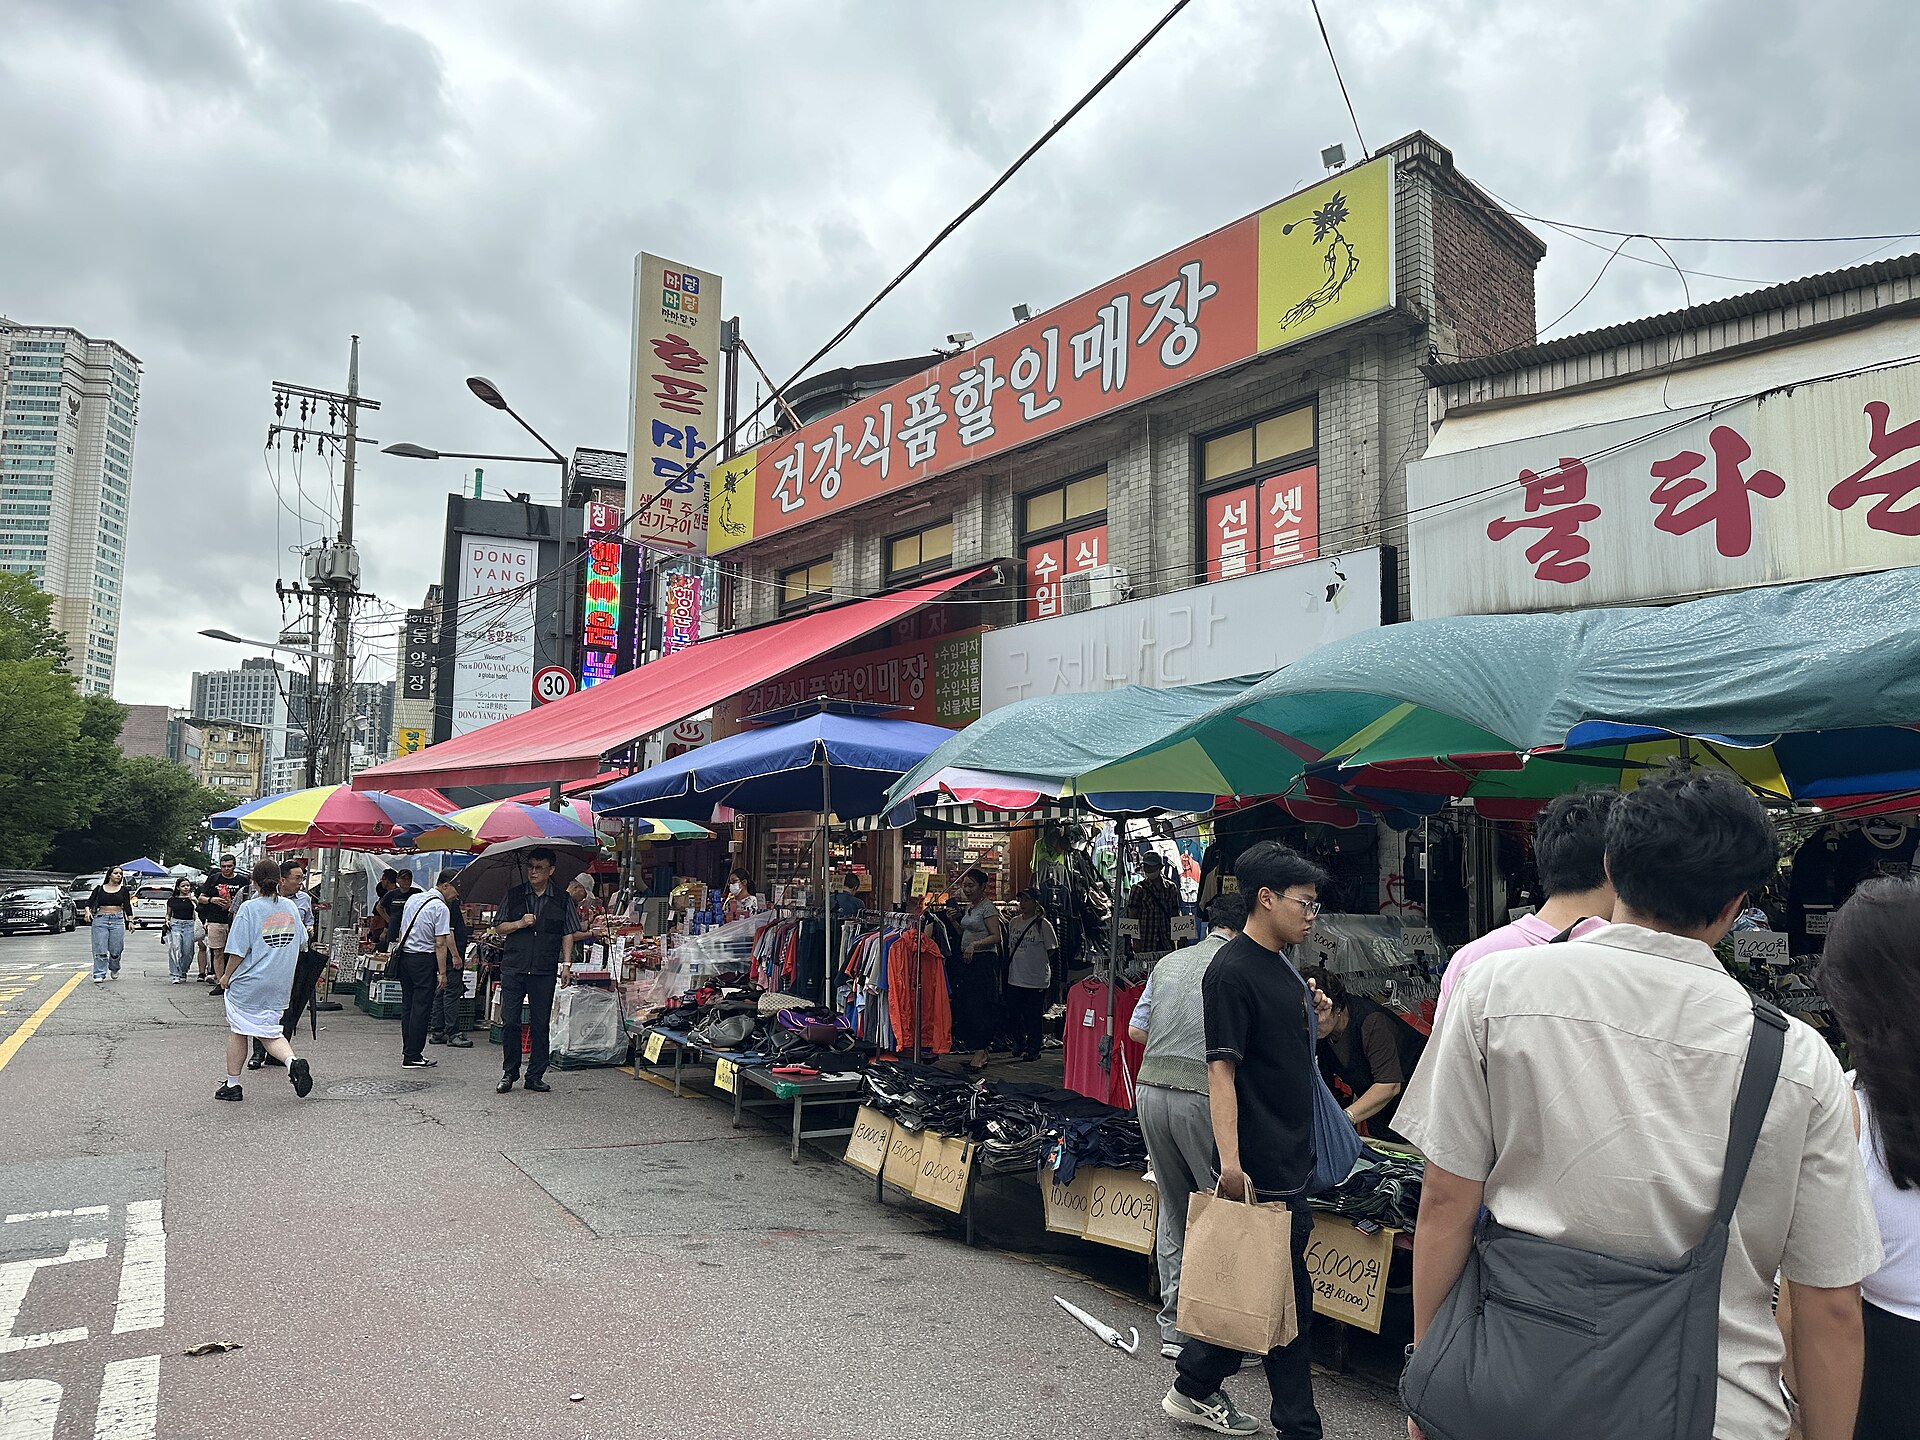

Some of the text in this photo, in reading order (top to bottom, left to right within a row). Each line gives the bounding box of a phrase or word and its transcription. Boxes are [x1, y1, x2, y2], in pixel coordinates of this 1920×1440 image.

[771, 261, 1218, 514] 건강식품할인매장
[639, 511, 691, 535] 전기구이
[473, 550, 526, 565] DONG
[473, 567, 525, 582] YANG
[405, 613, 435, 624] HOTEL
[409, 628, 428, 691] 동양장
[940, 639, 979, 661] 수입과자
[473, 662, 492, 671] DONG
[494, 663, 511, 672] YANG
[941, 658, 980, 680] 건강식품
[544, 675, 565, 695] 30
[941, 677, 980, 698] 수입식품
[458, 711, 478, 719] DONG
[479, 712, 496, 720] YANG
